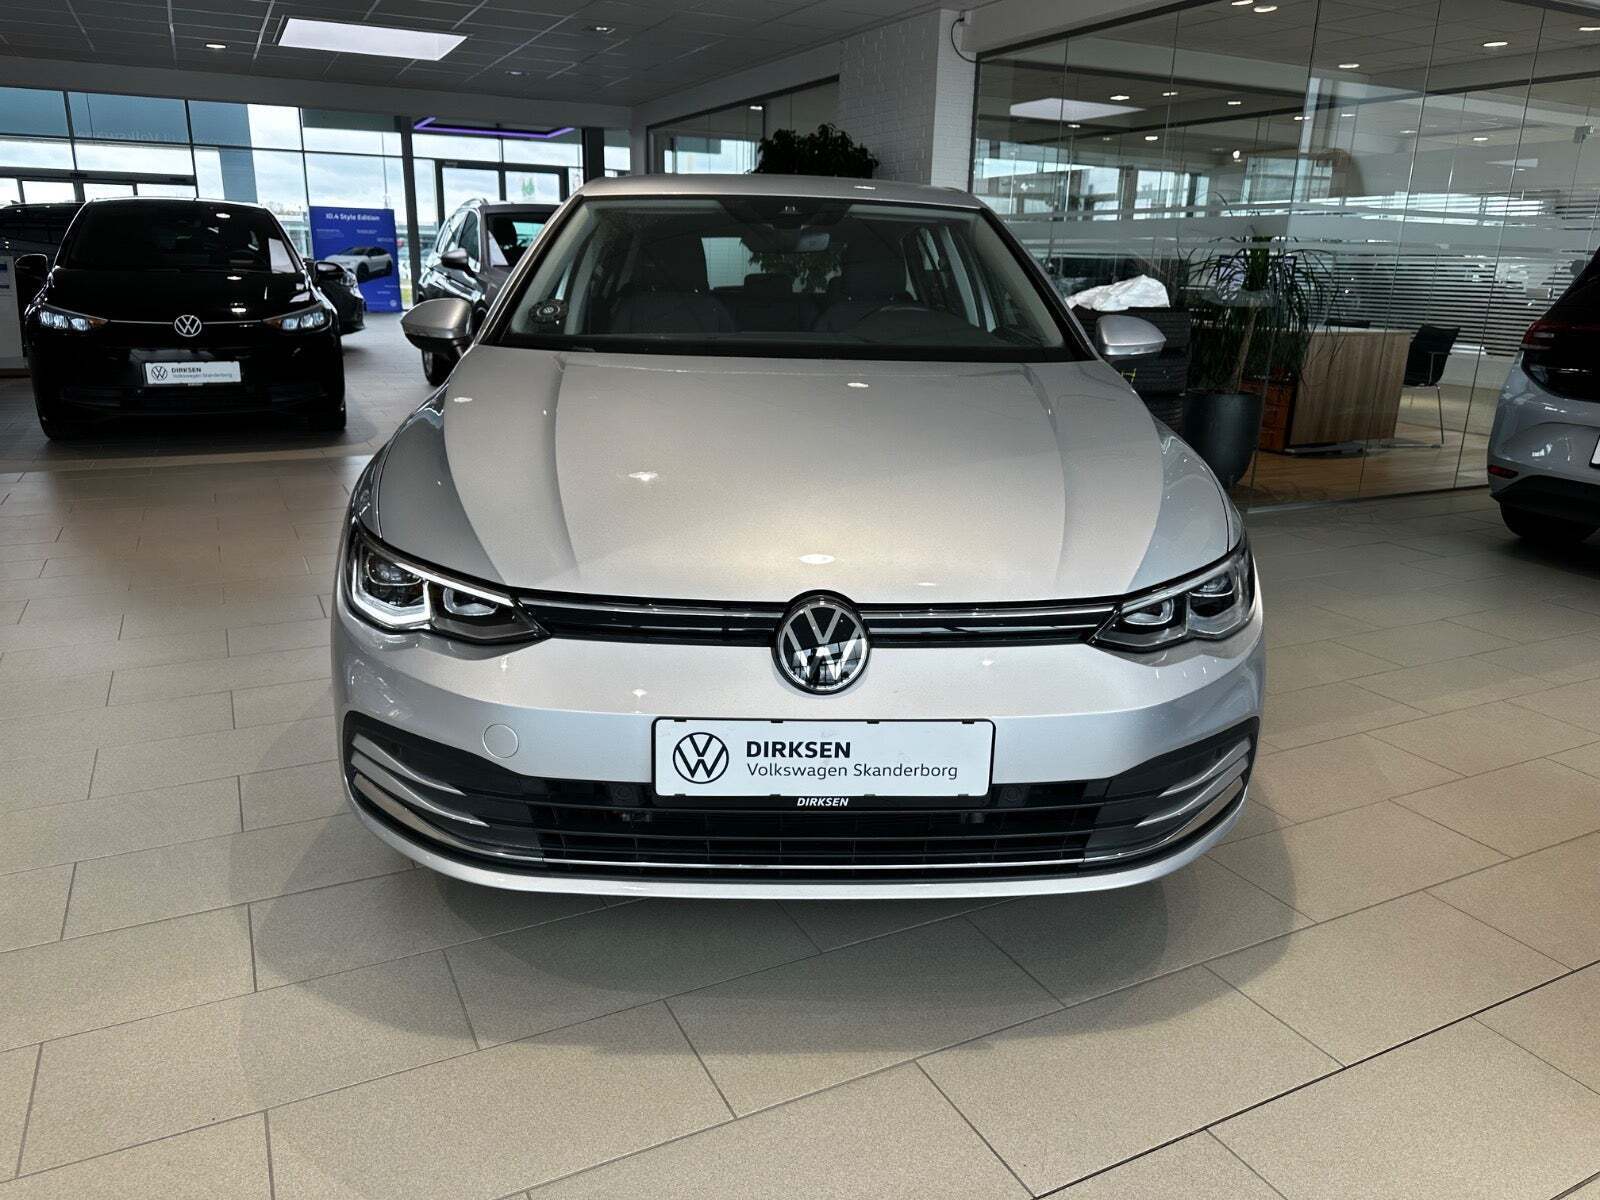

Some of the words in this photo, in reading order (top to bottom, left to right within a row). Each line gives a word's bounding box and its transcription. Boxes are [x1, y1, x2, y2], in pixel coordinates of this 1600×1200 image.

[340, 213, 356, 222] Style
[746, 740, 851, 759] DIRKSEN
[747, 763, 848, 780] Volkswagen
[853, 762, 959, 780] Skanderborg
[796, 796, 849, 807] DIRKSEN
